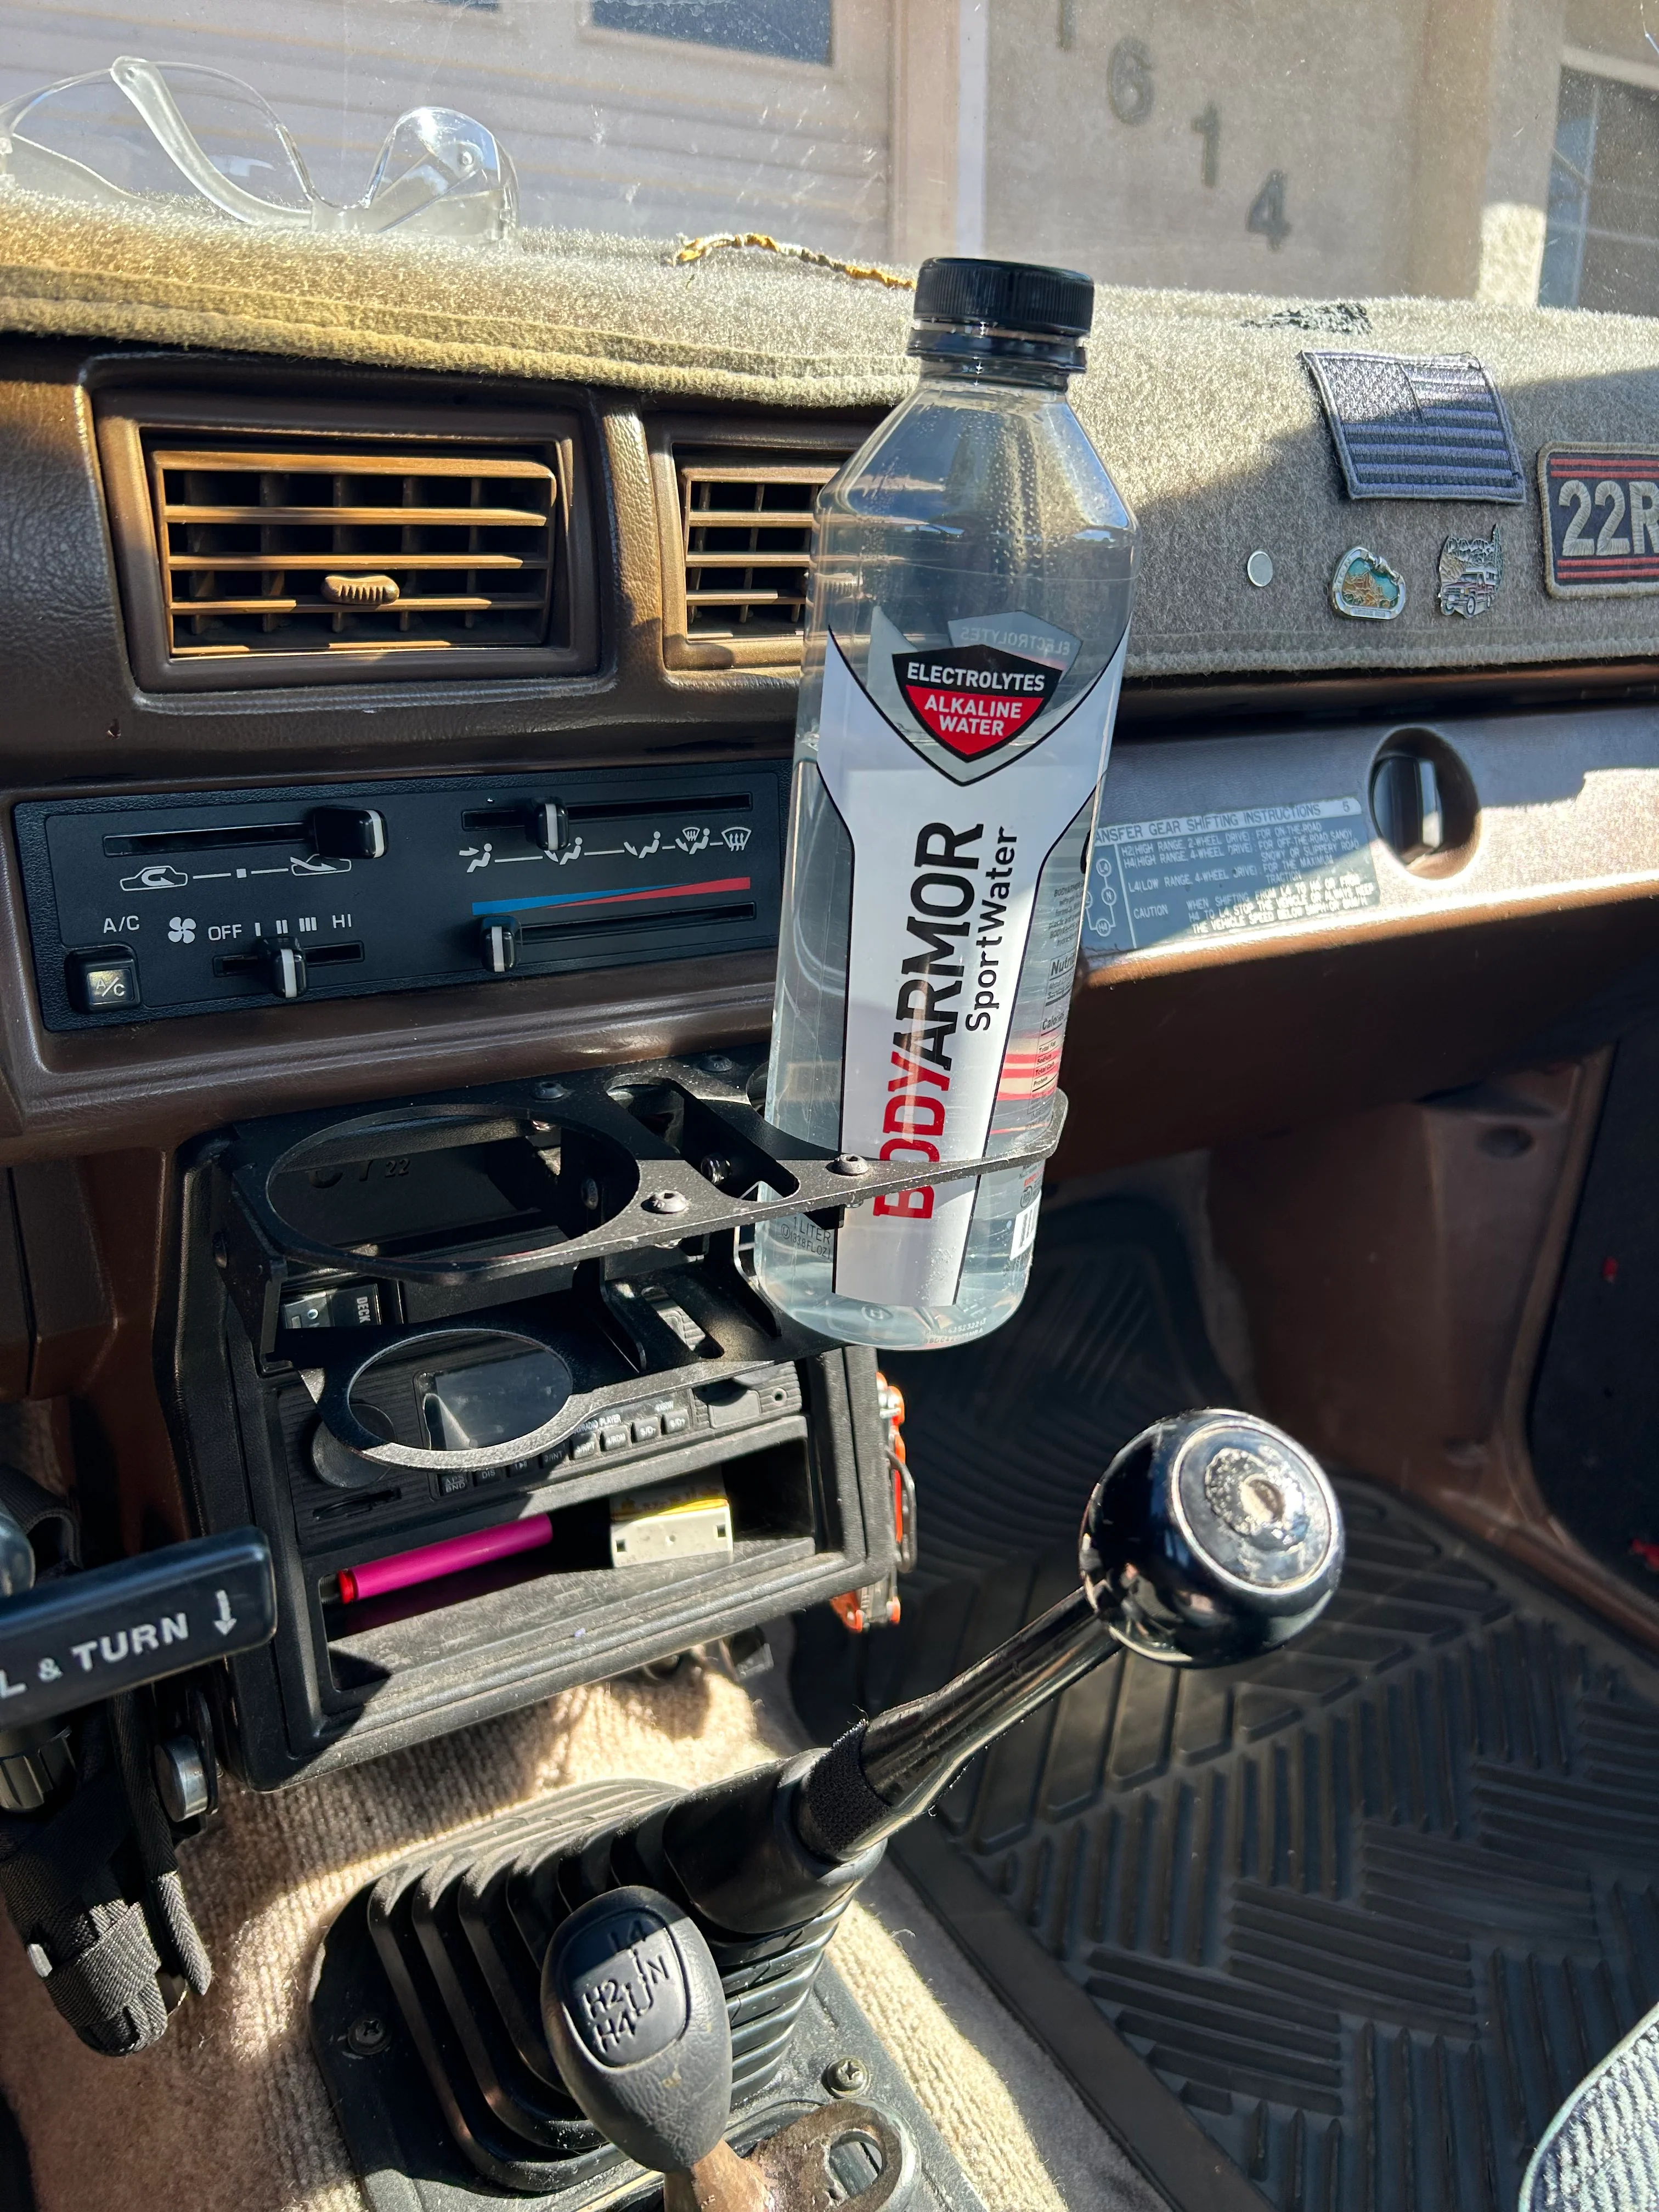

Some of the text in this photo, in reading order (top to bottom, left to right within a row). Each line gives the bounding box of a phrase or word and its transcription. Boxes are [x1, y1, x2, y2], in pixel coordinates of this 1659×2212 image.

[1559, 479, 1659, 557] 22R
[907, 662, 1046, 692] ELECTROLYTES
[924, 694, 1023, 719] ALKALINE
[939, 714, 1005, 737] WATER
[1096, 800, 1351, 844] ANSFER GEAR SHIFTING INSTRUCTIONS 5
[1256, 827, 1271, 839] FOR
[1258, 839, 1274, 851] FOR
[1289, 847, 1301, 858] OR
[1303, 842, 1338, 856] SLIPPERY
[1341, 838, 1359, 850] ROAD
[1262, 862, 1279, 874] FOR
[1282, 859, 1297, 871] THE
[1299, 854, 1334, 868] MAXIMUM
[1266, 871, 1302, 885] TRACTION
[1133, 904, 1169, 920] CAUTION
[1186, 898, 1210, 911] WHEN
[1254, 887, 1277, 901] FROM
[1295, 881, 1307, 895] TO
[1204, 909, 1216, 919] TO
[1233, 902, 1255, 918] STOP
[1256, 899, 1274, 912] THE
[1275, 893, 1308, 909] VEHICLE
[103, 915, 141, 935] A/C
[207, 924, 244, 942] OFF
[331, 913, 353, 930] HI
[965, 825, 1018, 1031] SportWater
[1190, 921, 1209, 934] THE
[1210, 914, 1246, 932] VEHICLE
[1248, 910, 1275, 926] SPEED
[95, 969, 126, 998] A/C
[799, 1220, 831, 1245] LITER
[357, 1296, 371, 1324] DECK
[599, 1413, 622, 1426] PLAYER
[38, 1657, 64, 1683] &
[71, 1612, 190, 1672] TURN
[644, 1954, 670, 1985] N
[582, 1978, 624, 2019] H2
[592, 2008, 637, 2053] H4
